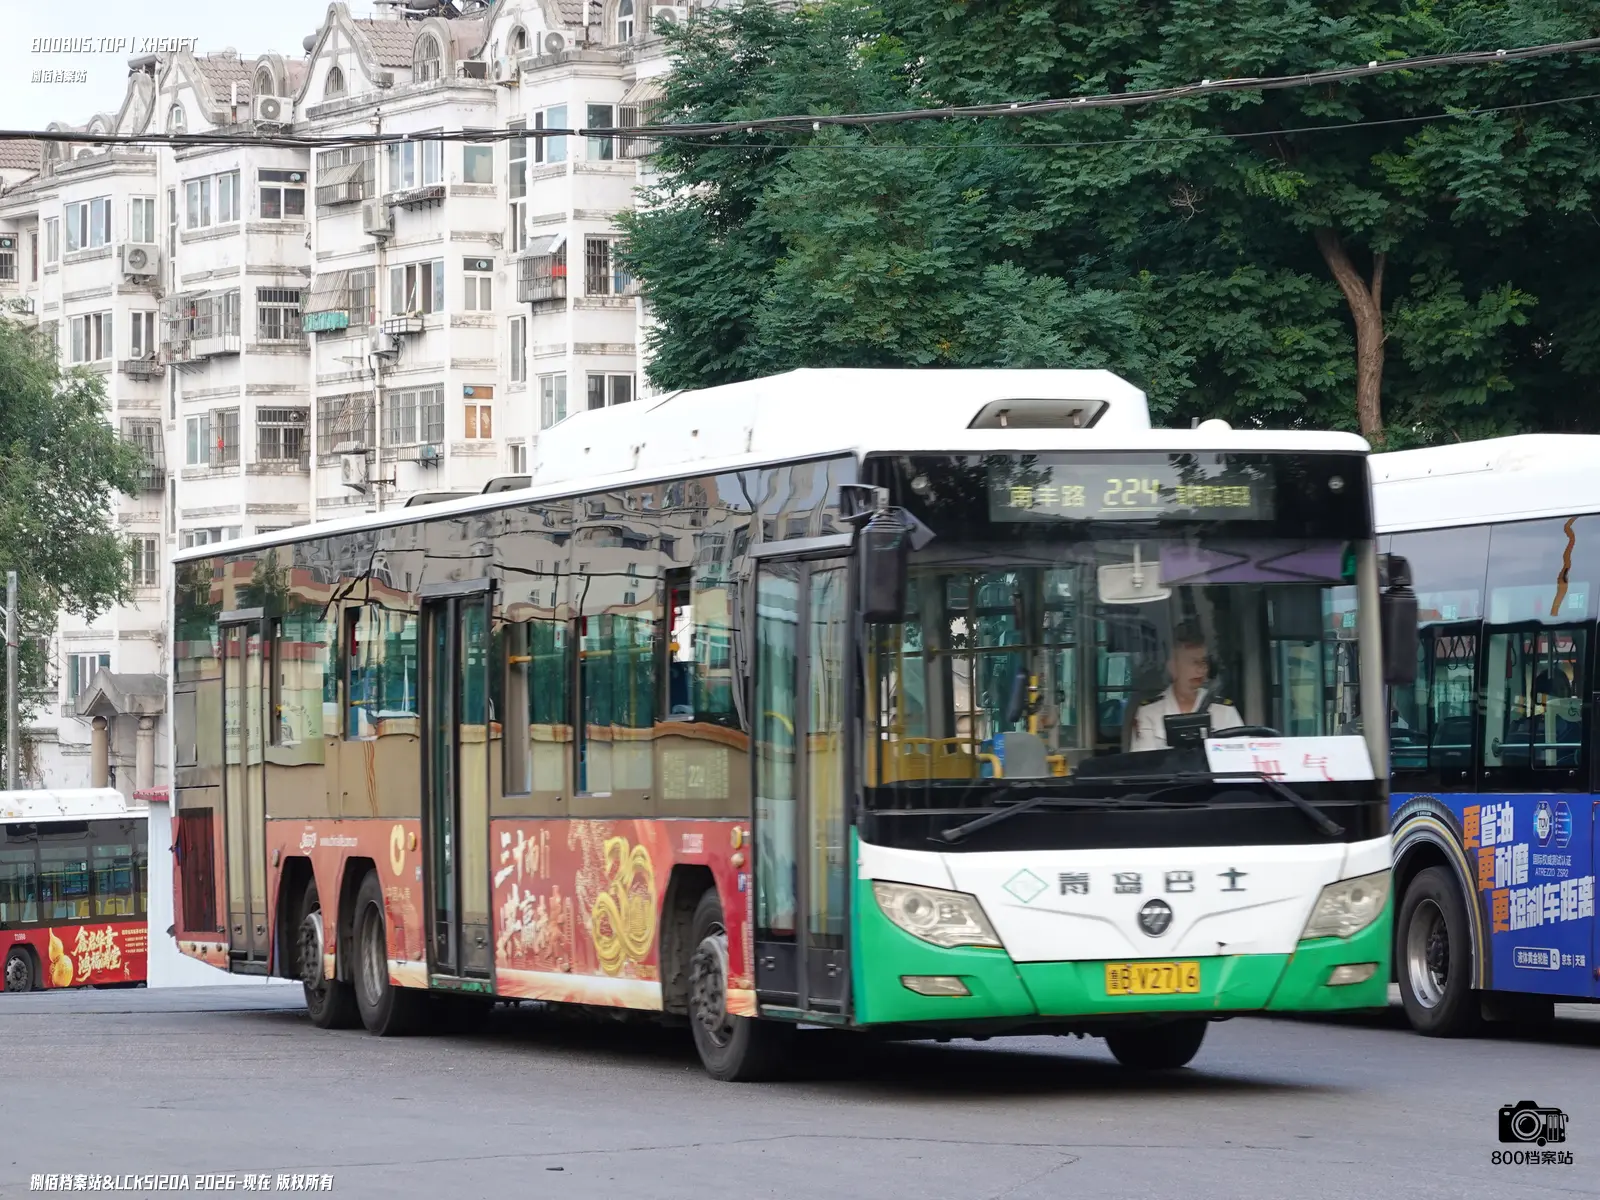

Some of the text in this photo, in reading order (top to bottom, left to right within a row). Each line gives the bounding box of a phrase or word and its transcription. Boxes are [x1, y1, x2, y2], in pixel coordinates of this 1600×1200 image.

[1102, 478, 1160, 506] 224
[1463, 801, 1514, 850] 更省油
[1058, 866, 1248, 896] 青岛巴士
[1478, 843, 1529, 892] 更耐磨
[1492, 875, 1595, 934] 更短刹车距离
